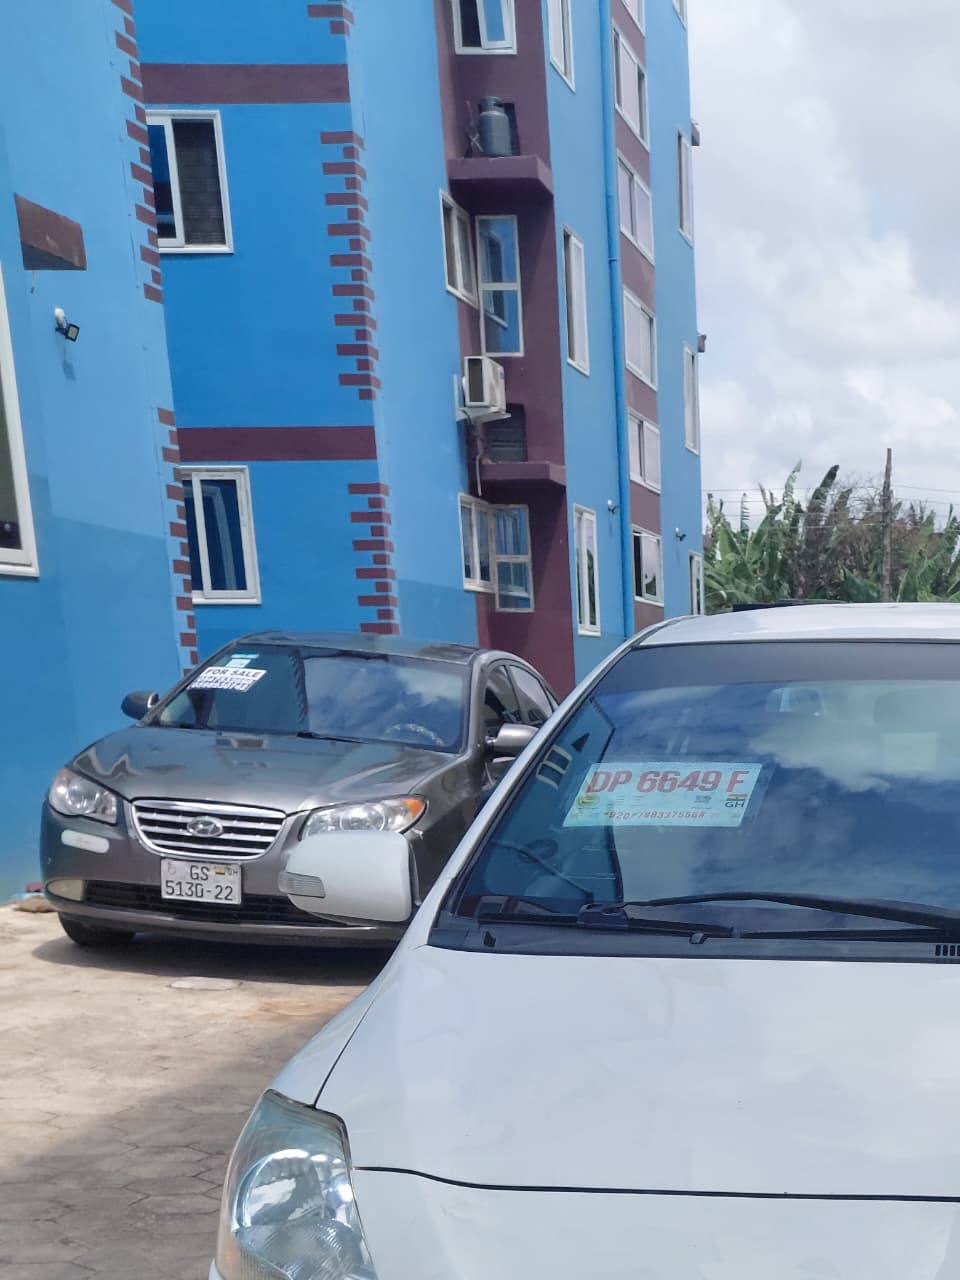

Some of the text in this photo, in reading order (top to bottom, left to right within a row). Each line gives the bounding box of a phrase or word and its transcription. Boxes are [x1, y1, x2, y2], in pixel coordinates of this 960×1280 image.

[206, 668, 260, 679] FOR SALE
[586, 770, 750, 794] DP 6649 F
[725, 801, 745, 809] GH
[190, 865, 210, 881] GS
